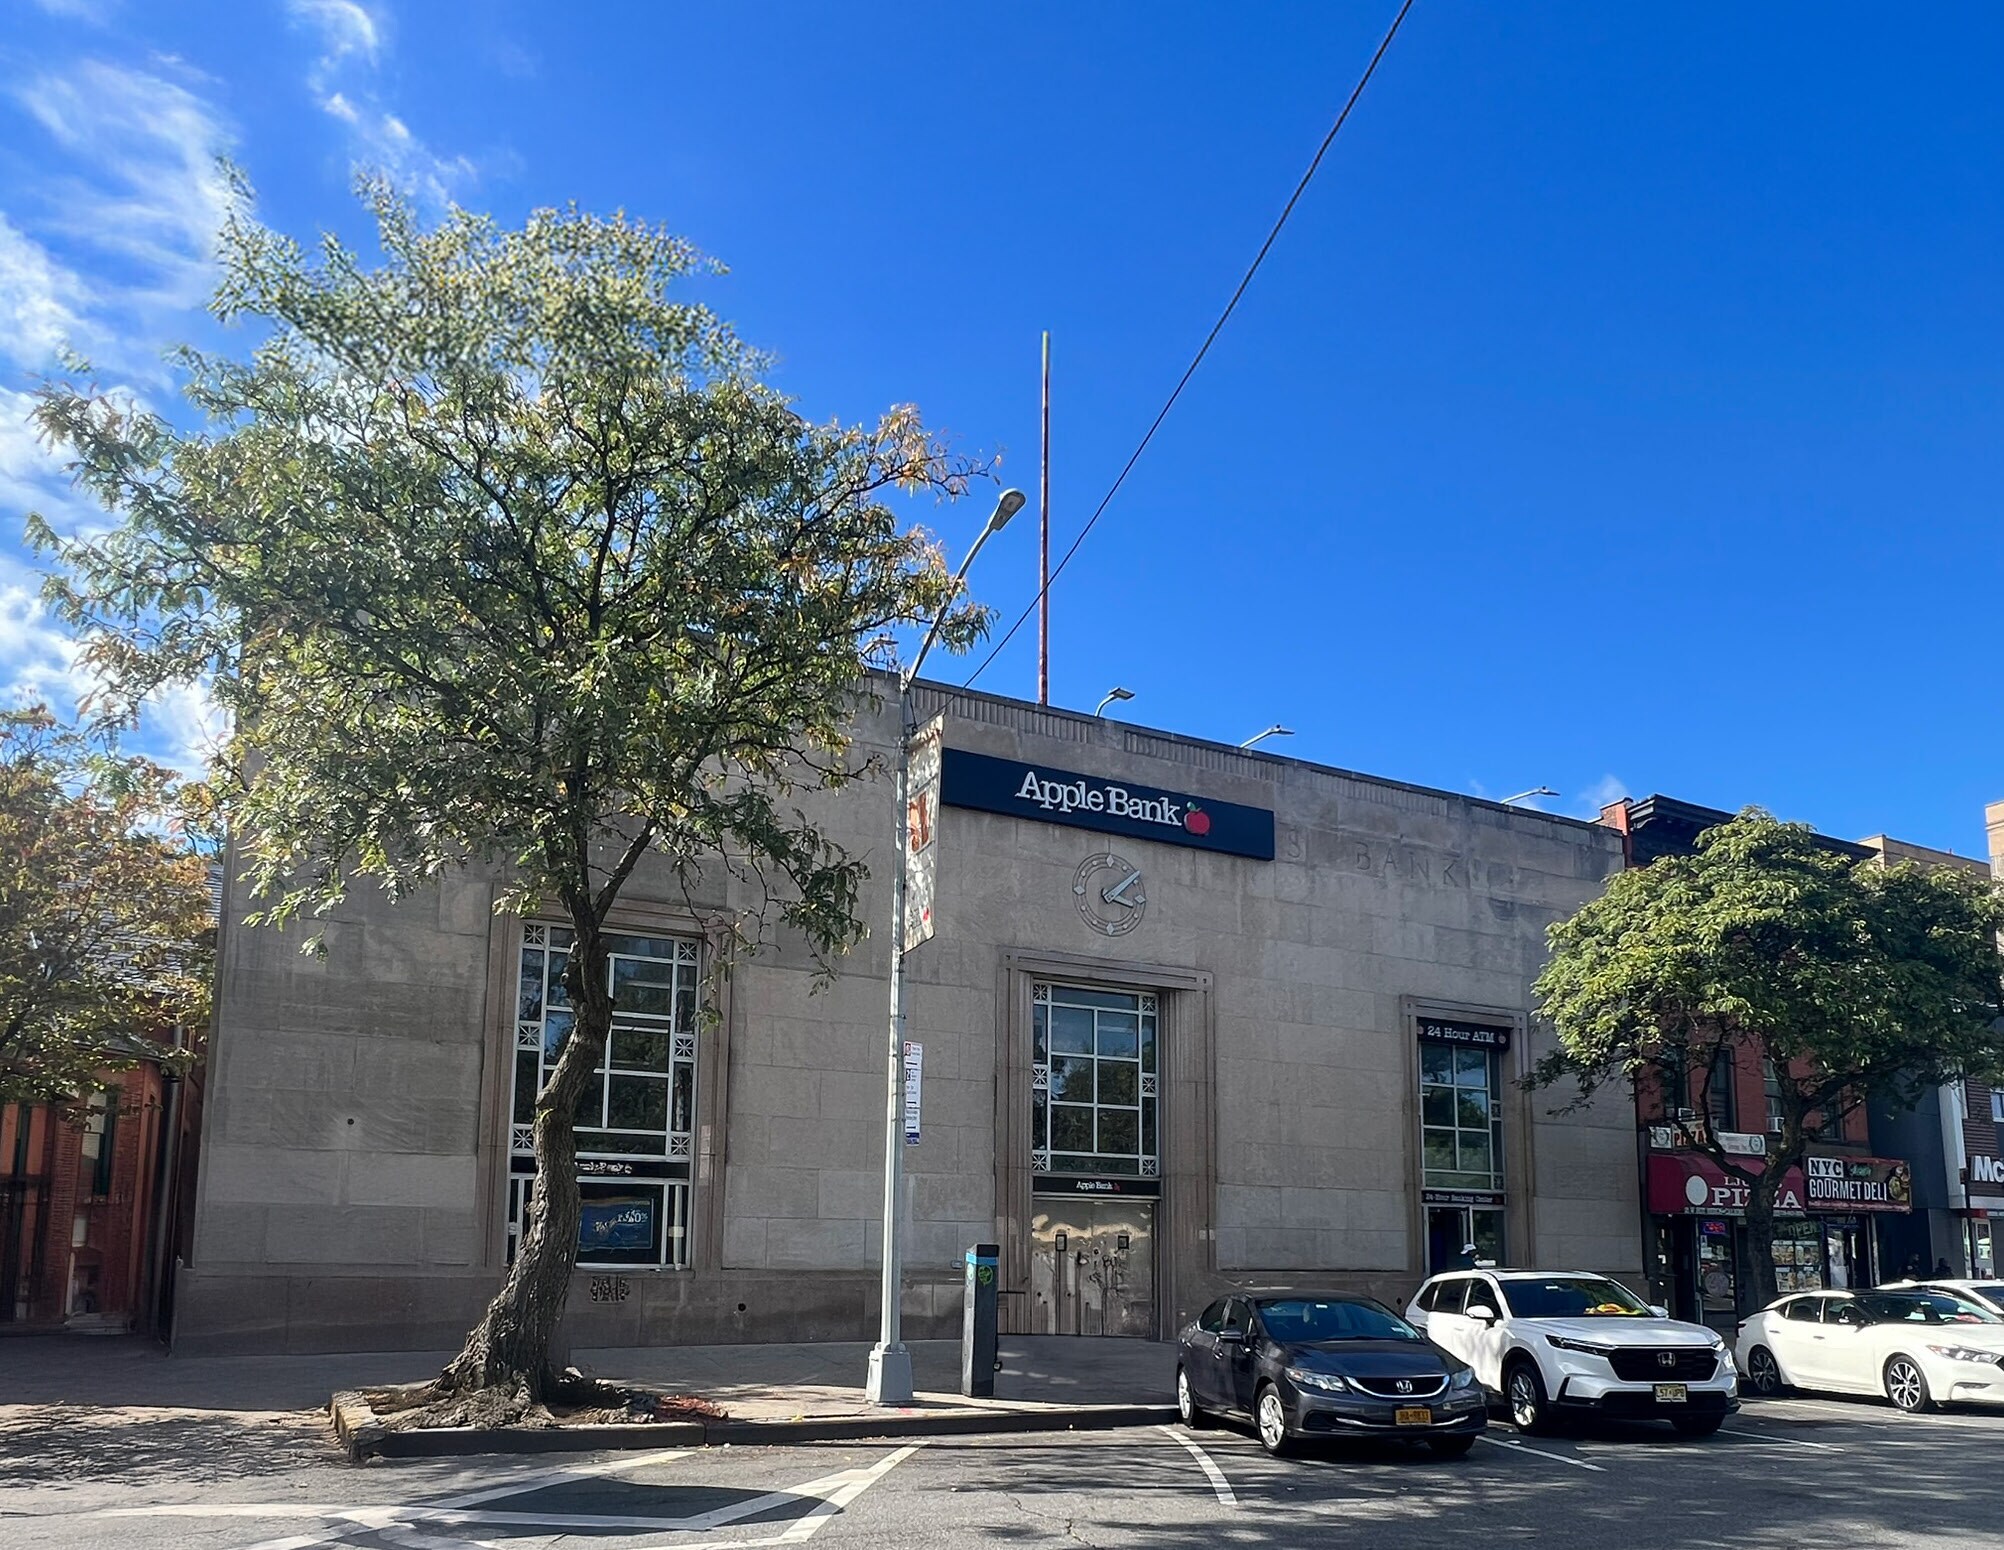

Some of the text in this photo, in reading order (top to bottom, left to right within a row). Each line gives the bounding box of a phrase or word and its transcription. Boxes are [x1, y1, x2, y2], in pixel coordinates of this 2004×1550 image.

[1015, 771, 1182, 827] Apple Bank
[1354, 841, 1461, 888] BANK
[1427, 1025, 1495, 1043] 24 Hour ATM
[1810, 1159, 1842, 1175] NYC
[1076, 1180, 1113, 1190] Apple Bank
[1809, 1178, 1887, 1201] GOURMET DELI
